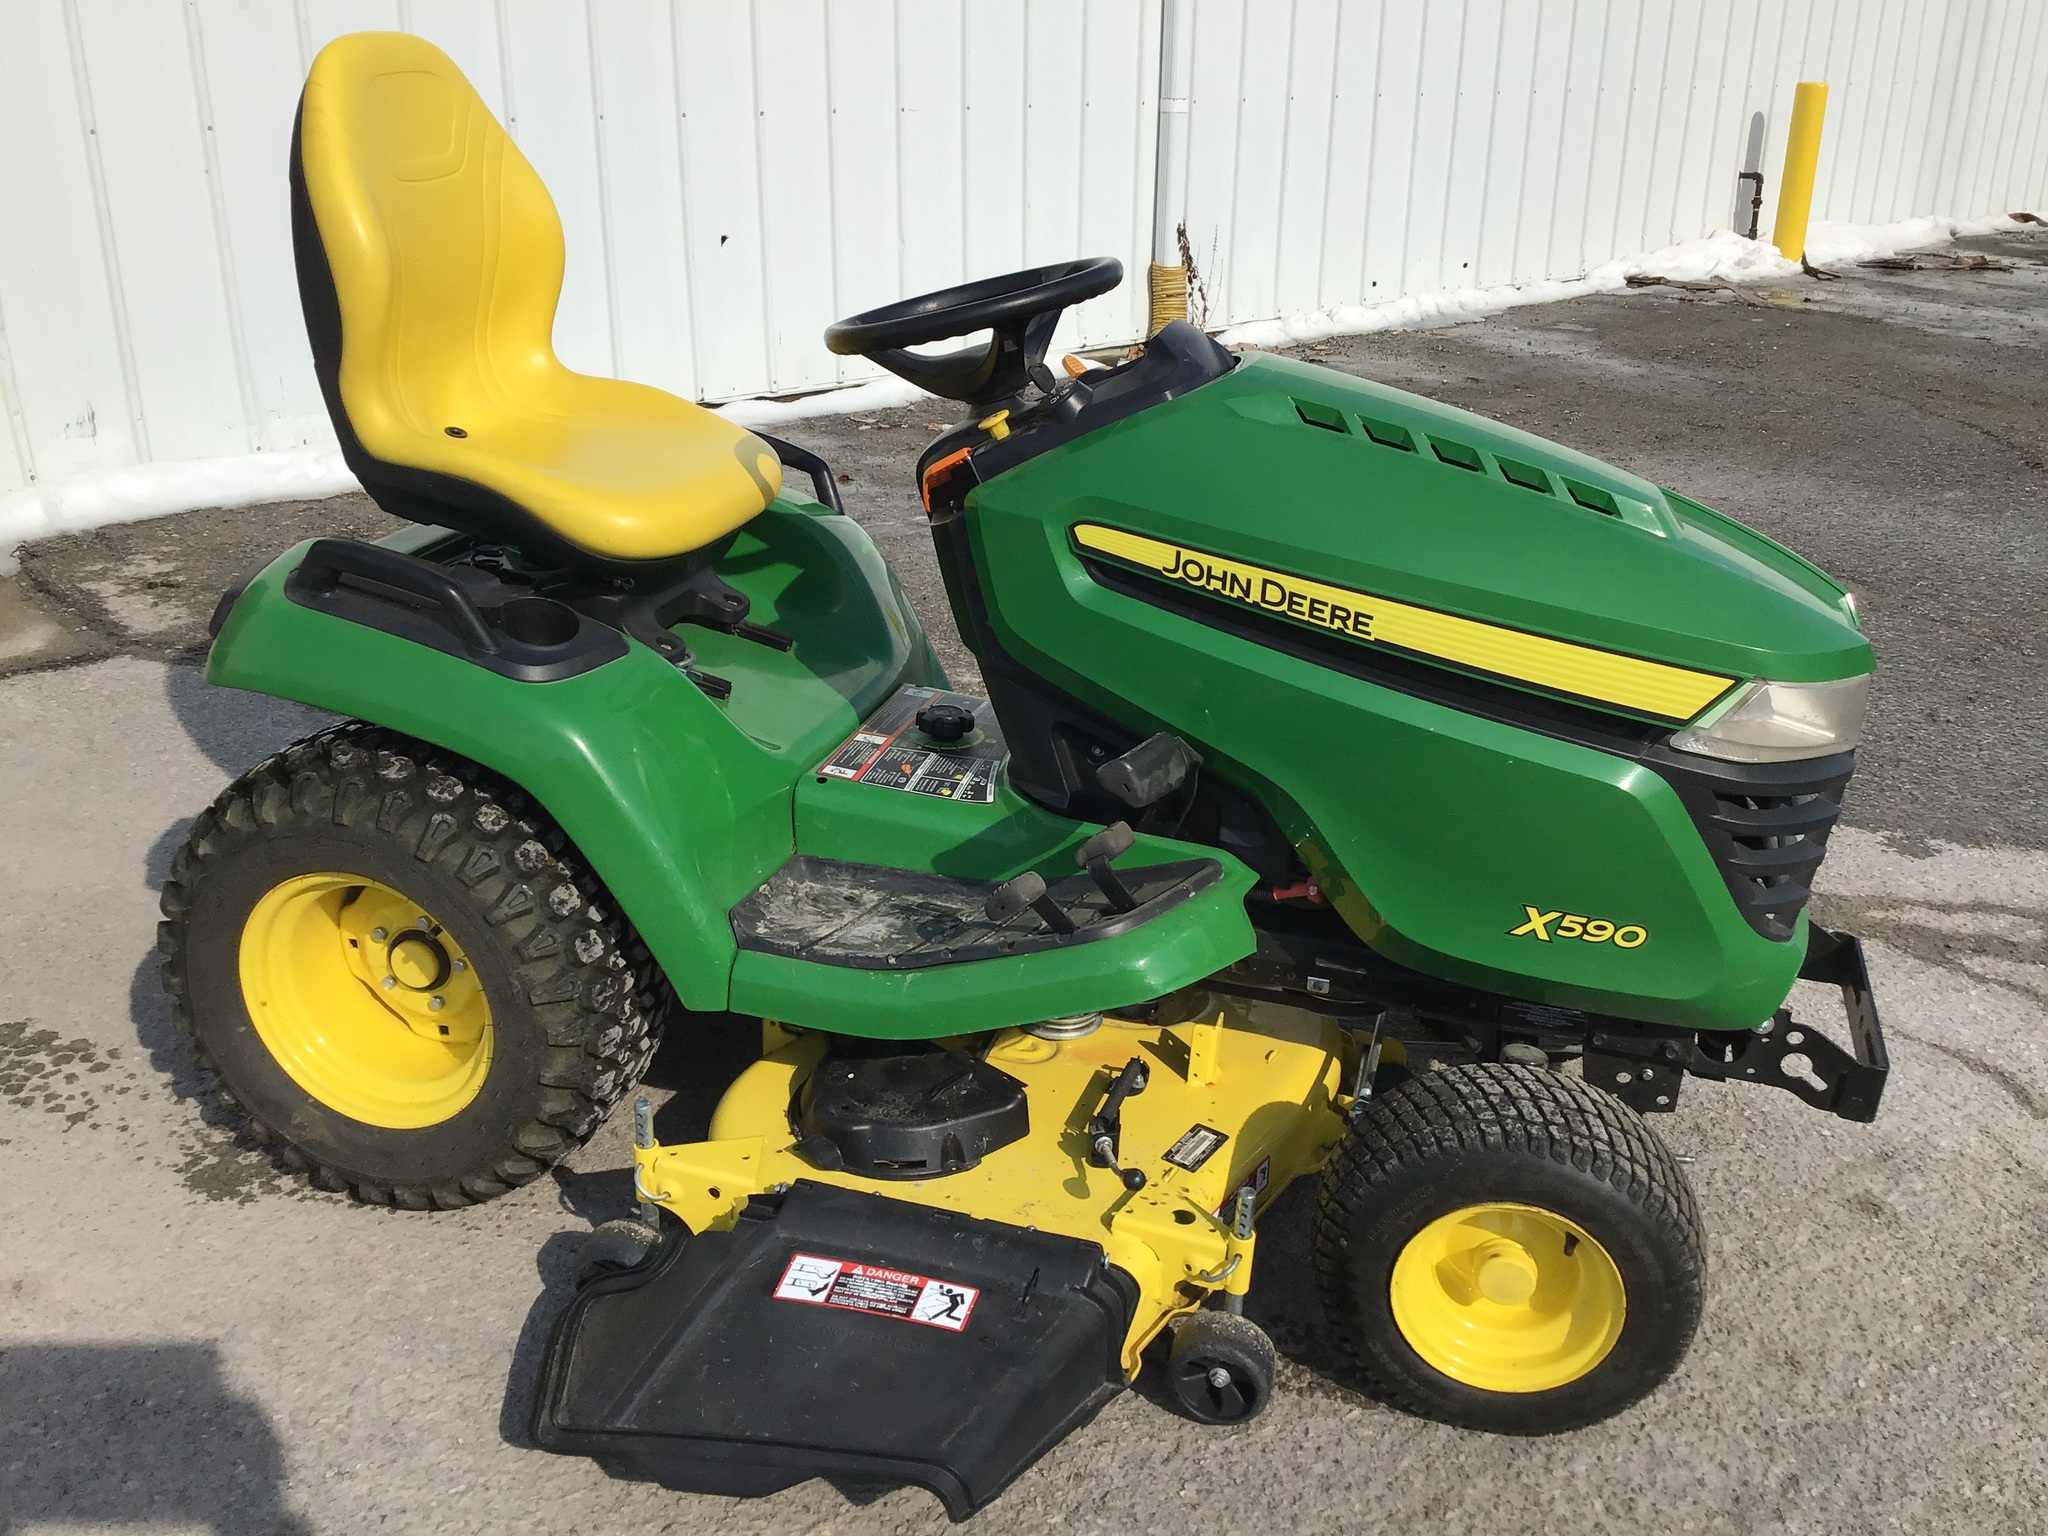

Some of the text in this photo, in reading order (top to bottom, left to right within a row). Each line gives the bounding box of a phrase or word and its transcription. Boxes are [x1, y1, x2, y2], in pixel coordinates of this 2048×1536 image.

[1161, 549, 1375, 638] JOHN DEERE
[1506, 903, 1649, 949] X590
[865, 1267, 920, 1285] DANGER
